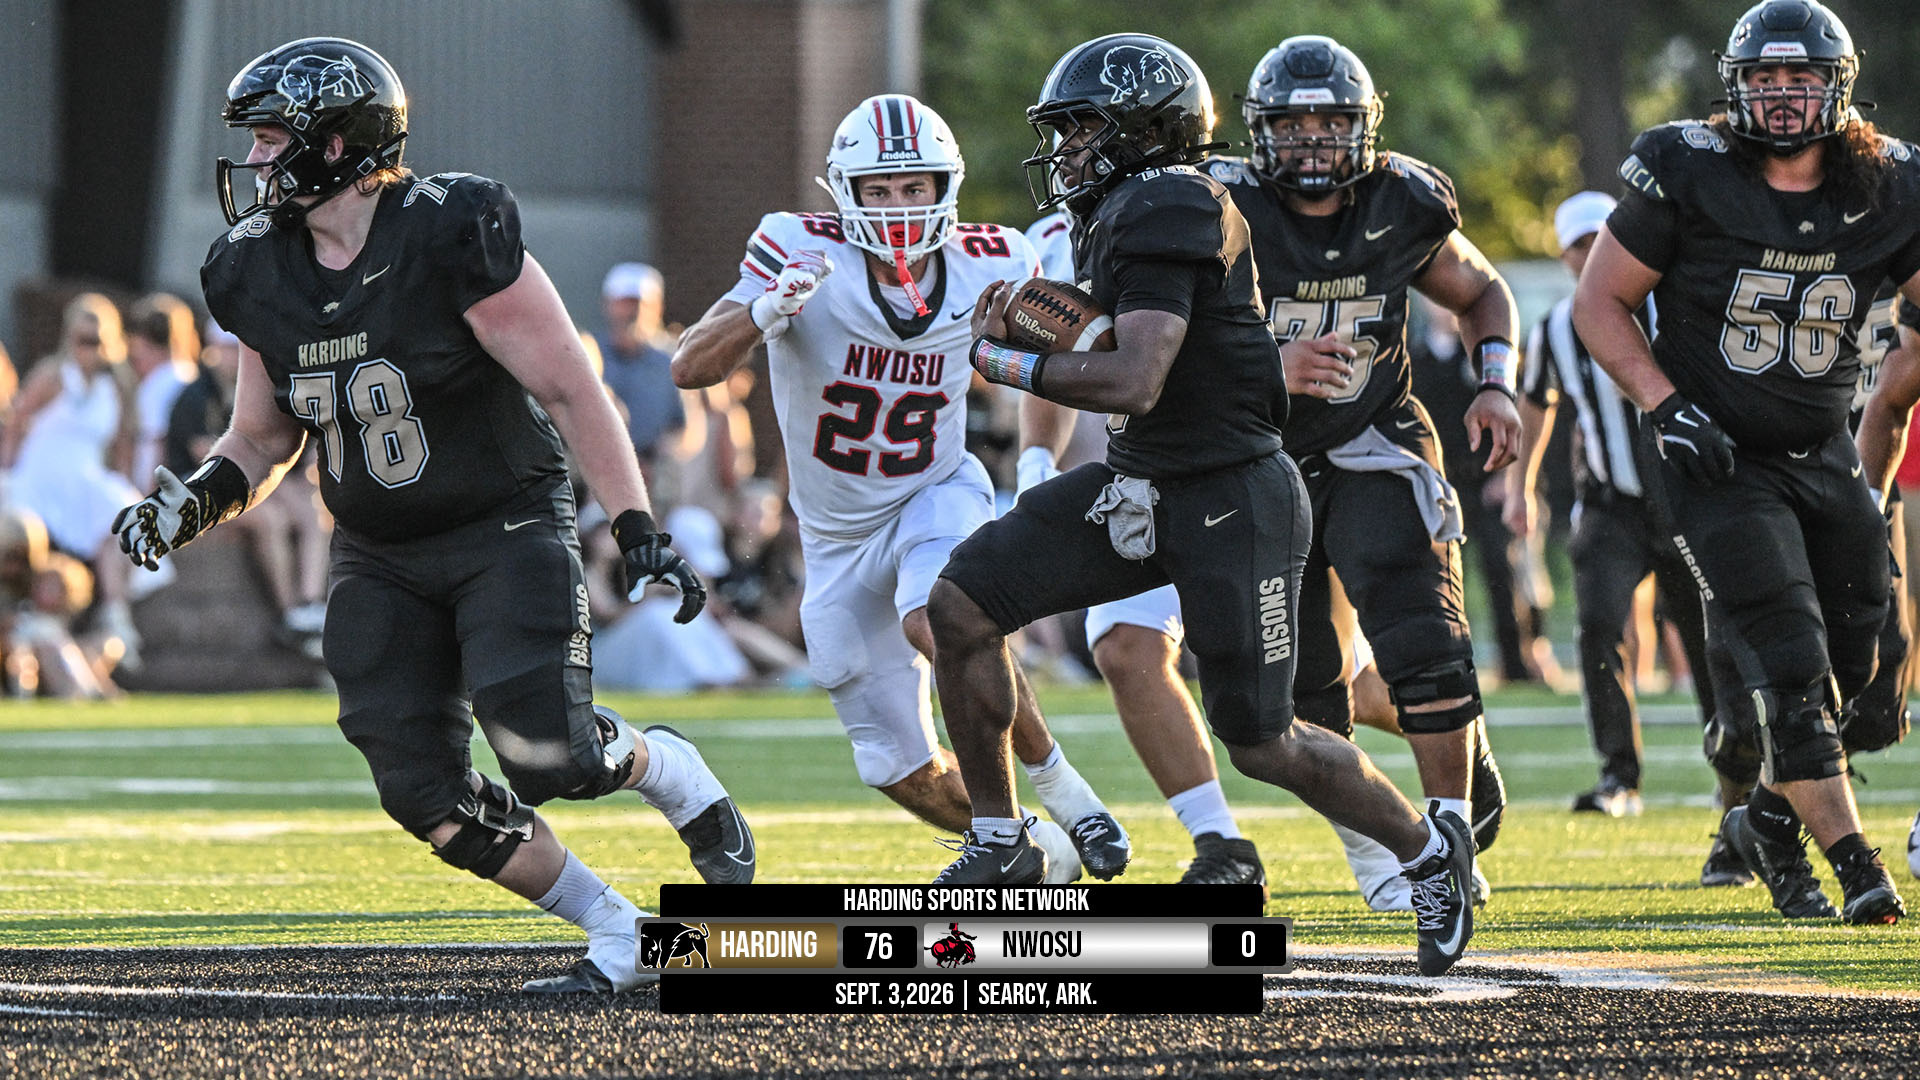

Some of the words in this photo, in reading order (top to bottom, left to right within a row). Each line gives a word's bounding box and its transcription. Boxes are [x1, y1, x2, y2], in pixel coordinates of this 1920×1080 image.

[881, 150, 919, 161] Riddell
[1761, 247, 1837, 272] HARDING
[1296, 274, 1367, 300] HARDING
[1014, 309, 1056, 343] Wilson
[1722, 269, 1857, 379] 56
[297, 331, 368, 368] HARDING
[843, 343, 946, 386] NWOSU
[290, 358, 430, 489] 78
[814, 380, 949, 479] 29
[1671, 534, 1714, 601] BISONS
[1258, 576, 1291, 665] BISONS
